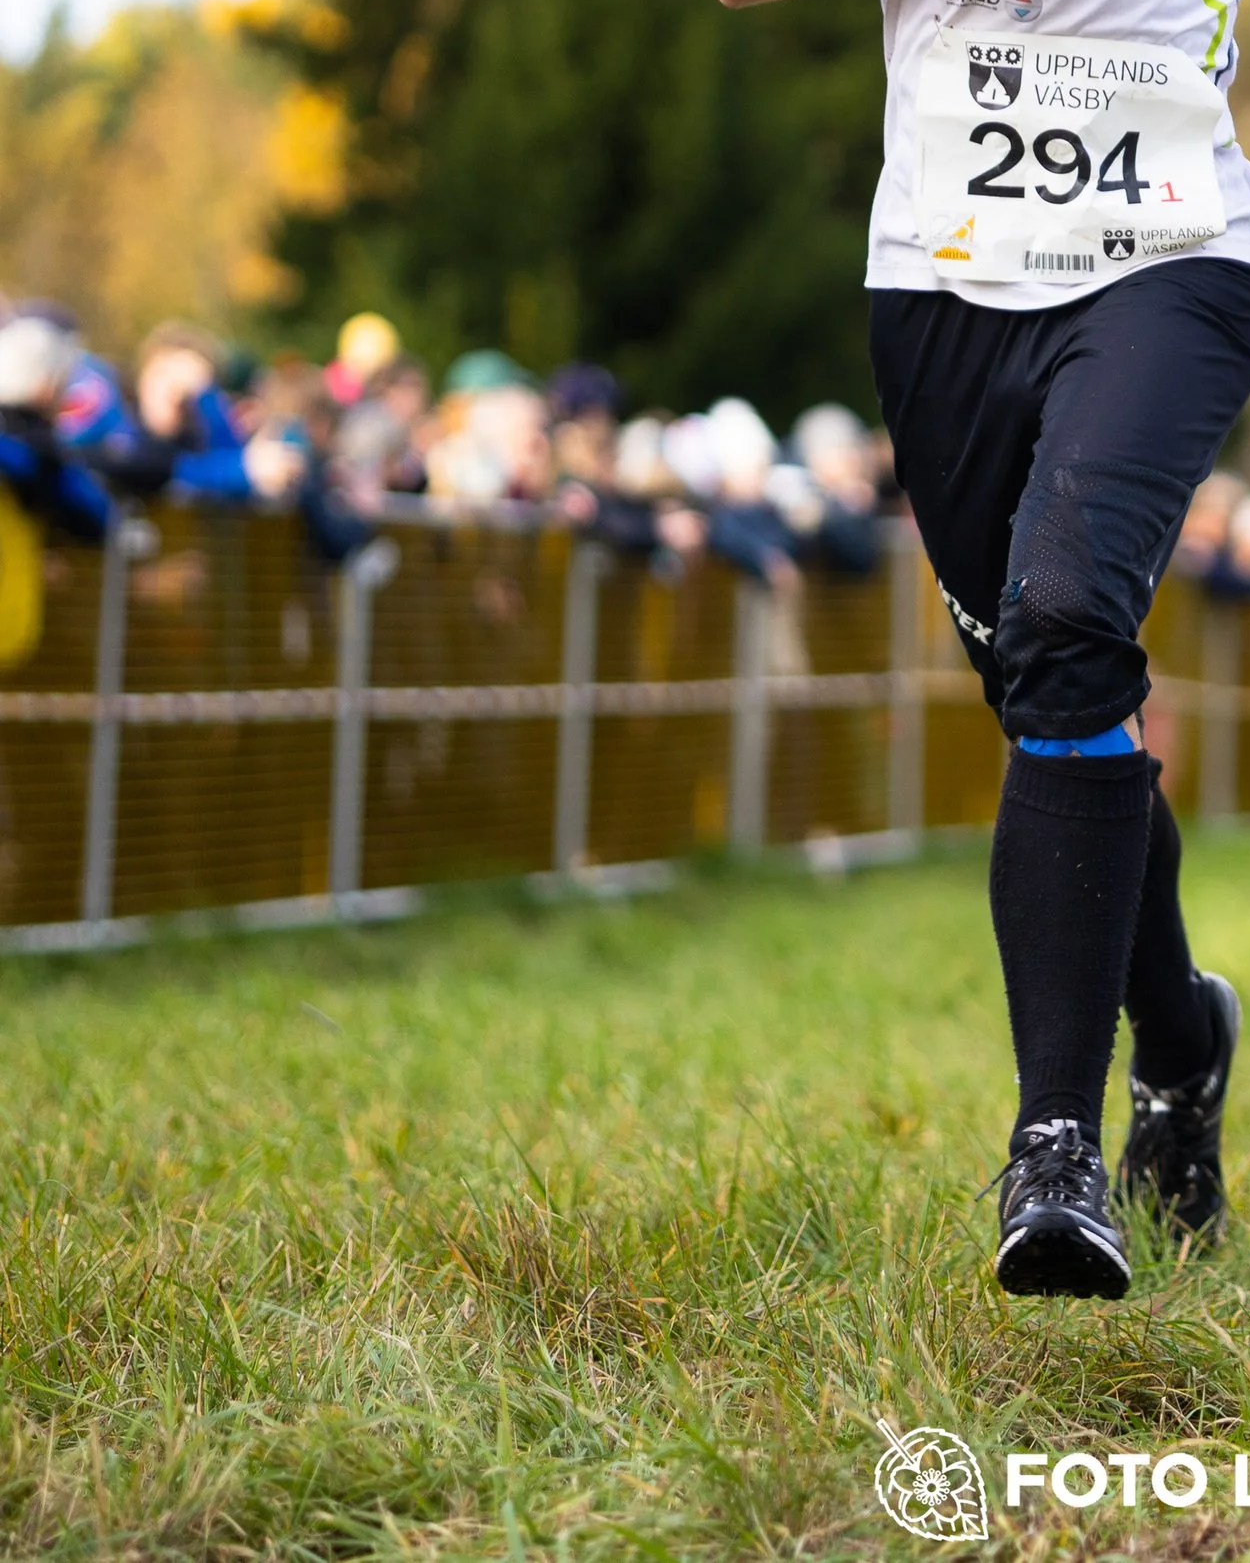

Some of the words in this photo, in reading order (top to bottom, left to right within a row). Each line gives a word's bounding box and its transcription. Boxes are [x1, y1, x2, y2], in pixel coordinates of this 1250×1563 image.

[1035, 53, 1169, 85] UPPLANDS
[1035, 81, 1117, 111] VÄSBY
[967, 121, 1150, 205] 294
[1158, 181, 1184, 203] 1
[1140, 225, 1216, 241] UPPLANDS
[1142, 241, 1187, 256] VÄSBY
